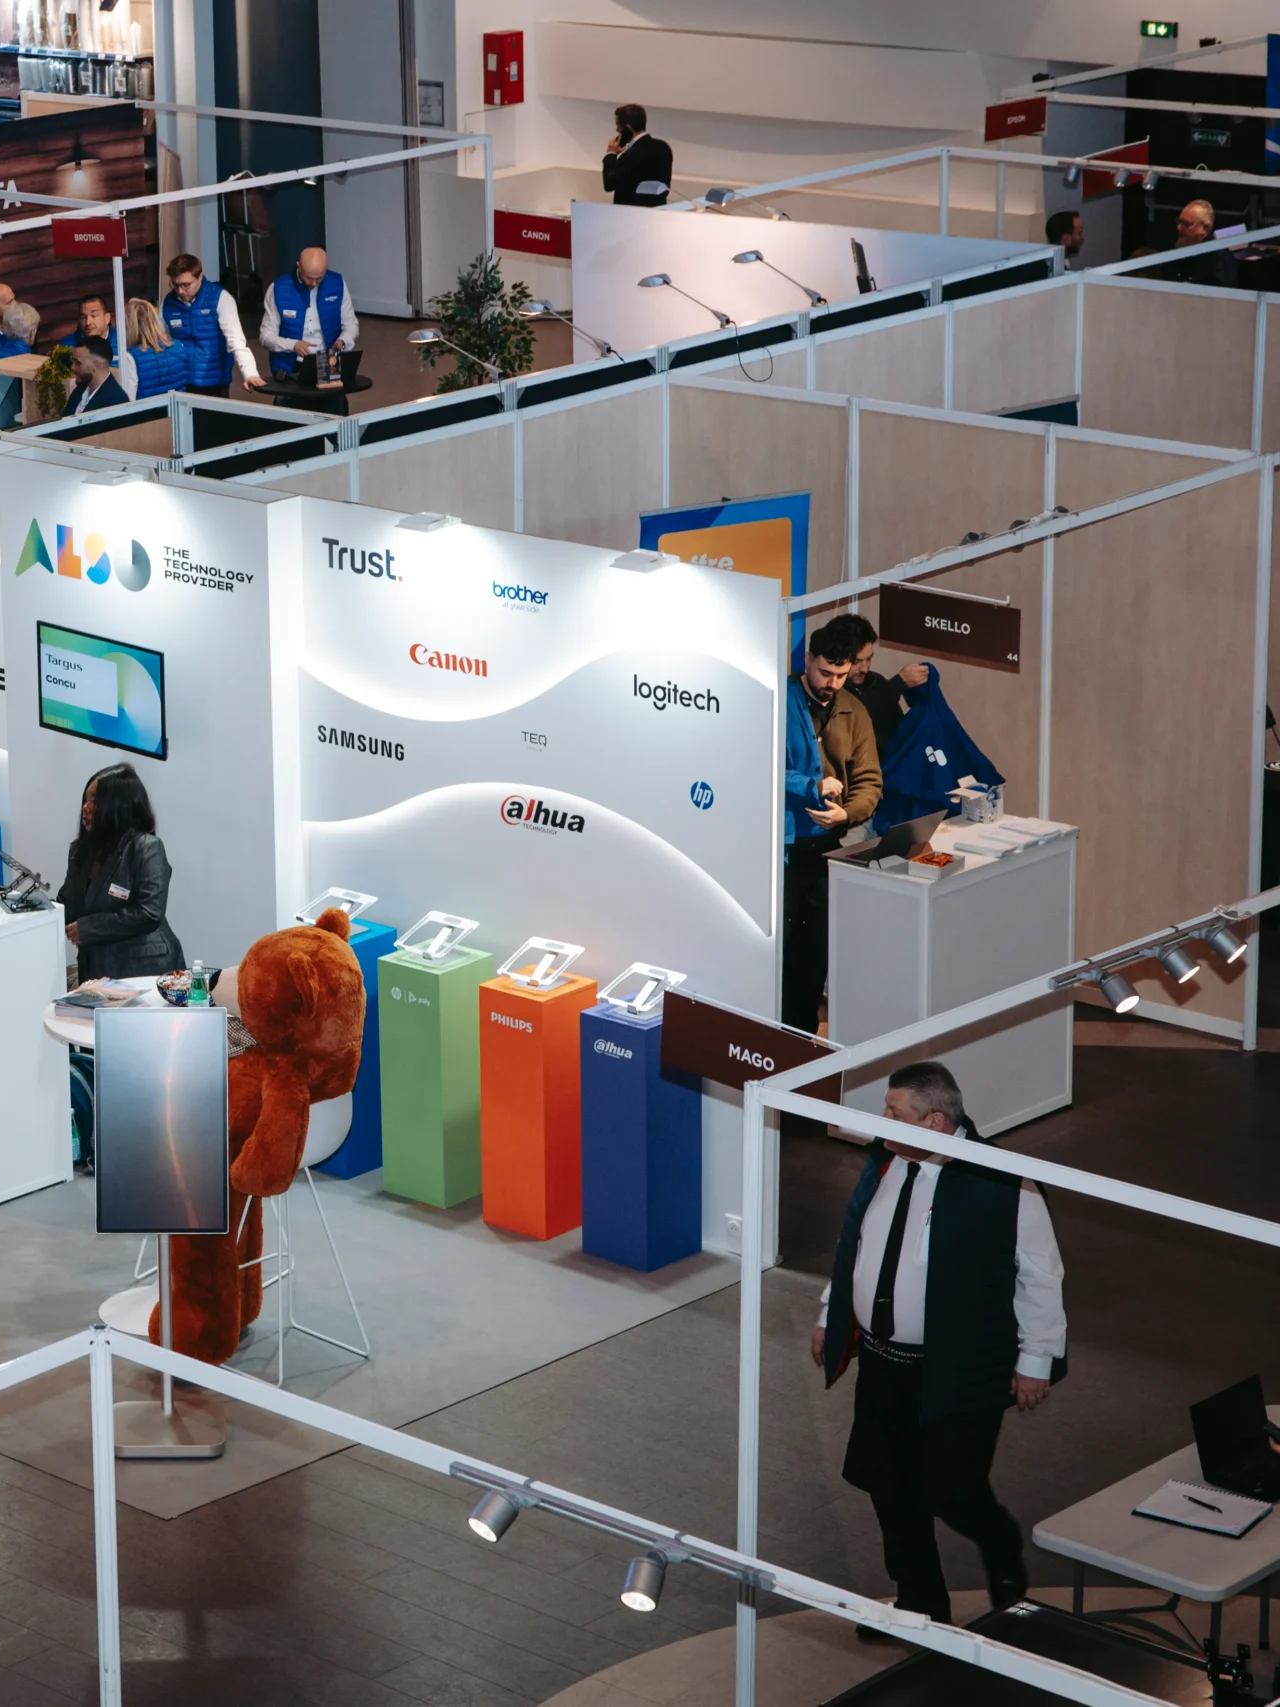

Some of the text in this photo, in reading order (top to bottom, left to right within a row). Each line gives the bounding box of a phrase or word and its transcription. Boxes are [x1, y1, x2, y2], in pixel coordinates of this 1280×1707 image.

[74, 233, 105, 242] BROTHER
[522, 229, 551, 242] CANON
[15, 517, 152, 592] ALSO
[164, 546, 190, 560] THE
[164, 558, 254, 584] TECHNOLOGY
[164, 570, 234, 592] PROVIDER
[492, 580, 549, 606] brother
[924, 616, 971, 636] SKELLO
[46, 653, 83, 671] Targus
[409, 642, 488, 678] Canon
[1007, 652, 1018, 662] 44
[46, 674, 76, 690] Conçu
[634, 674, 720, 714] logitech
[317, 724, 405, 762] SAMSUNG
[521, 730, 547, 748] TEQ
[690, 780, 714, 811] hp
[523, 822, 558, 836] TECHNOLOGY
[490, 1012, 533, 1033] PHILIPS
[728, 1042, 775, 1073] MAGO
